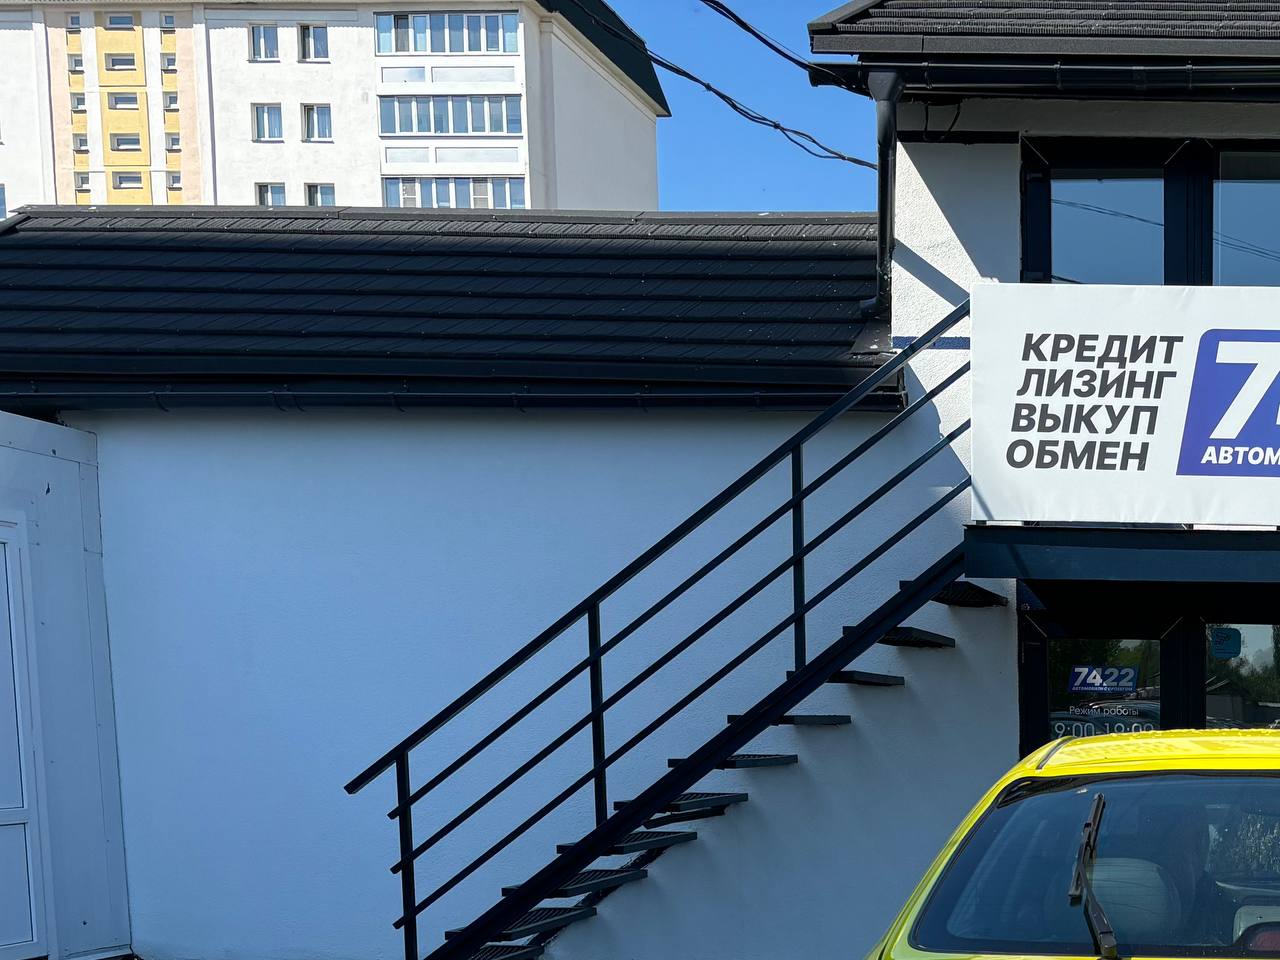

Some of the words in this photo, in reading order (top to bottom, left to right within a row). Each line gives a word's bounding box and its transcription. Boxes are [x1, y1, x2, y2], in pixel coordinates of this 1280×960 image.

[1021, 333, 1184, 369] КРЕДИТ
[1016, 368, 1177, 399] ЛИЗИНГ
[1011, 403, 1159, 435] ВЫКУП
[1006, 438, 1150, 471] ОБМЕН
[1074, 667, 1135, 687] 7422
[1069, 706, 1100, 715] Режим
[1104, 706, 1138, 717] работы
